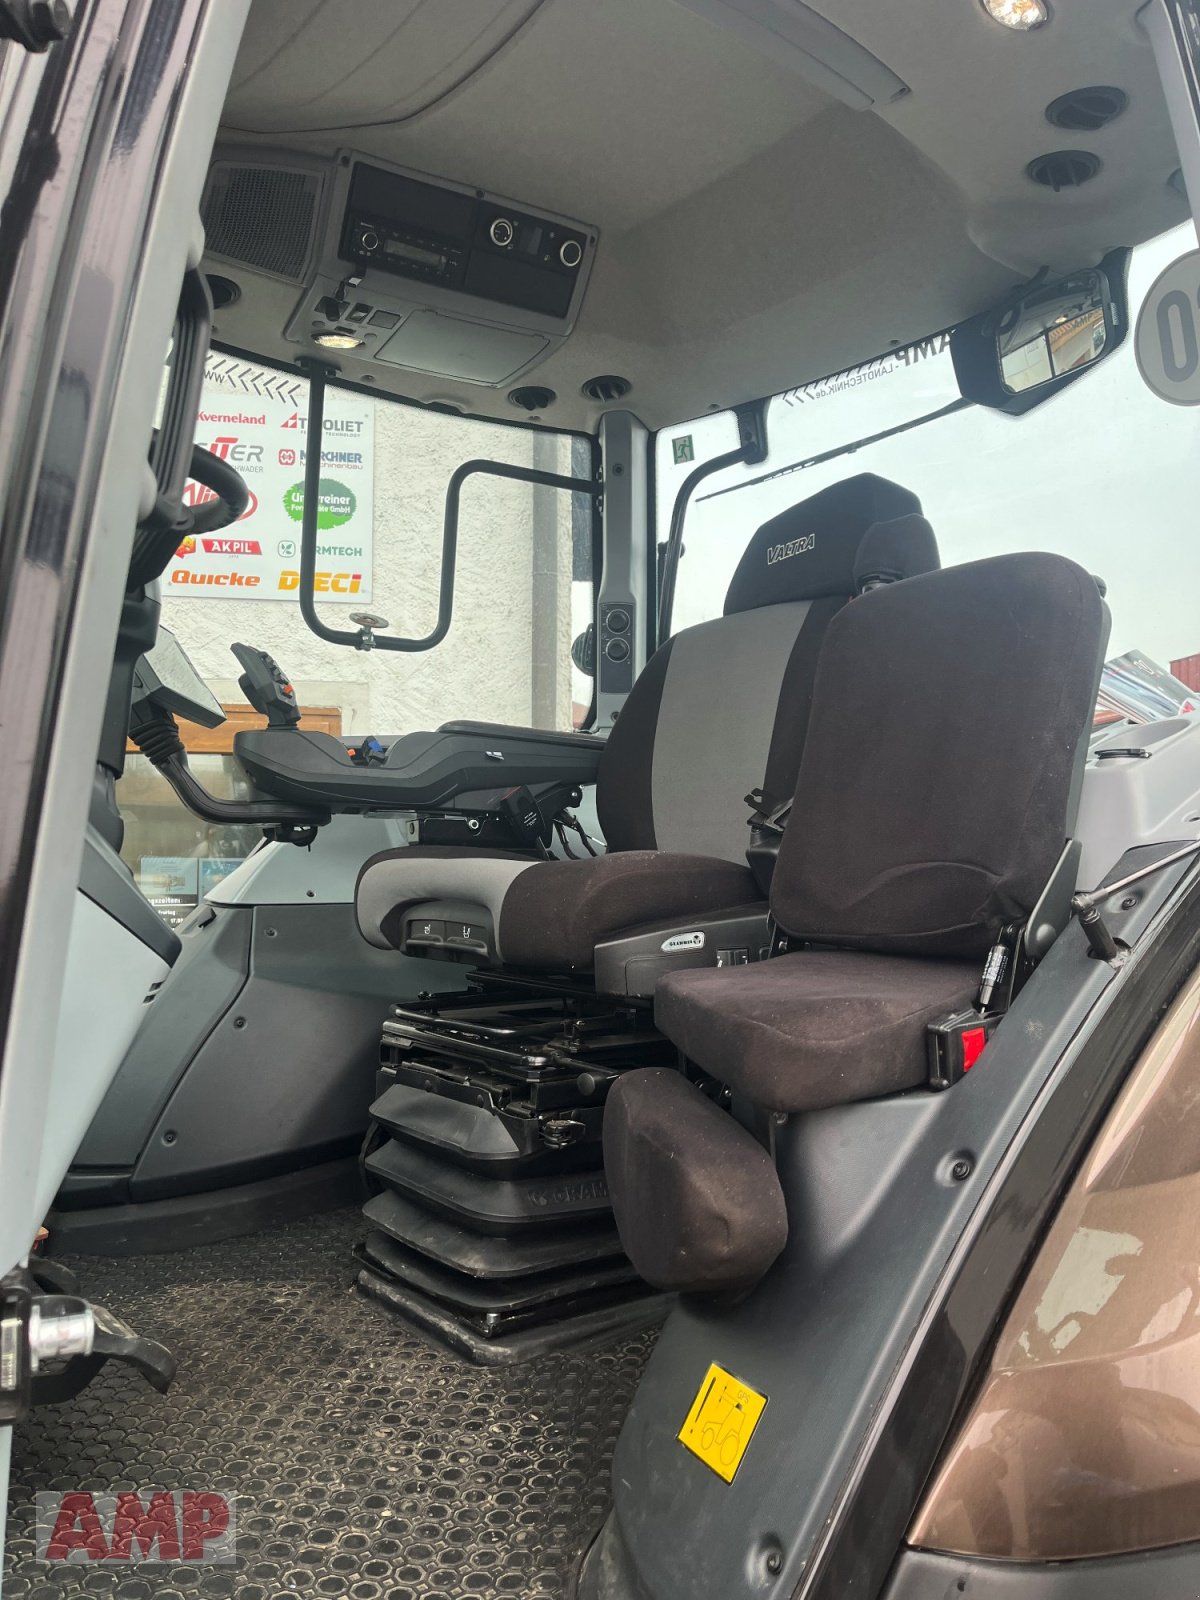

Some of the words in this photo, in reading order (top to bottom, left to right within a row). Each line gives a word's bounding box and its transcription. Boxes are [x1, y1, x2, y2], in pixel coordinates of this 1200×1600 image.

[298, 417, 363, 433] TOLIET
[211, 540, 252, 553] AKPIL
[315, 545, 363, 557] RMTECH
[767, 533, 815, 566] VALTRA
[171, 569, 261, 587] Quicke
[277, 570, 362, 594] DECI
